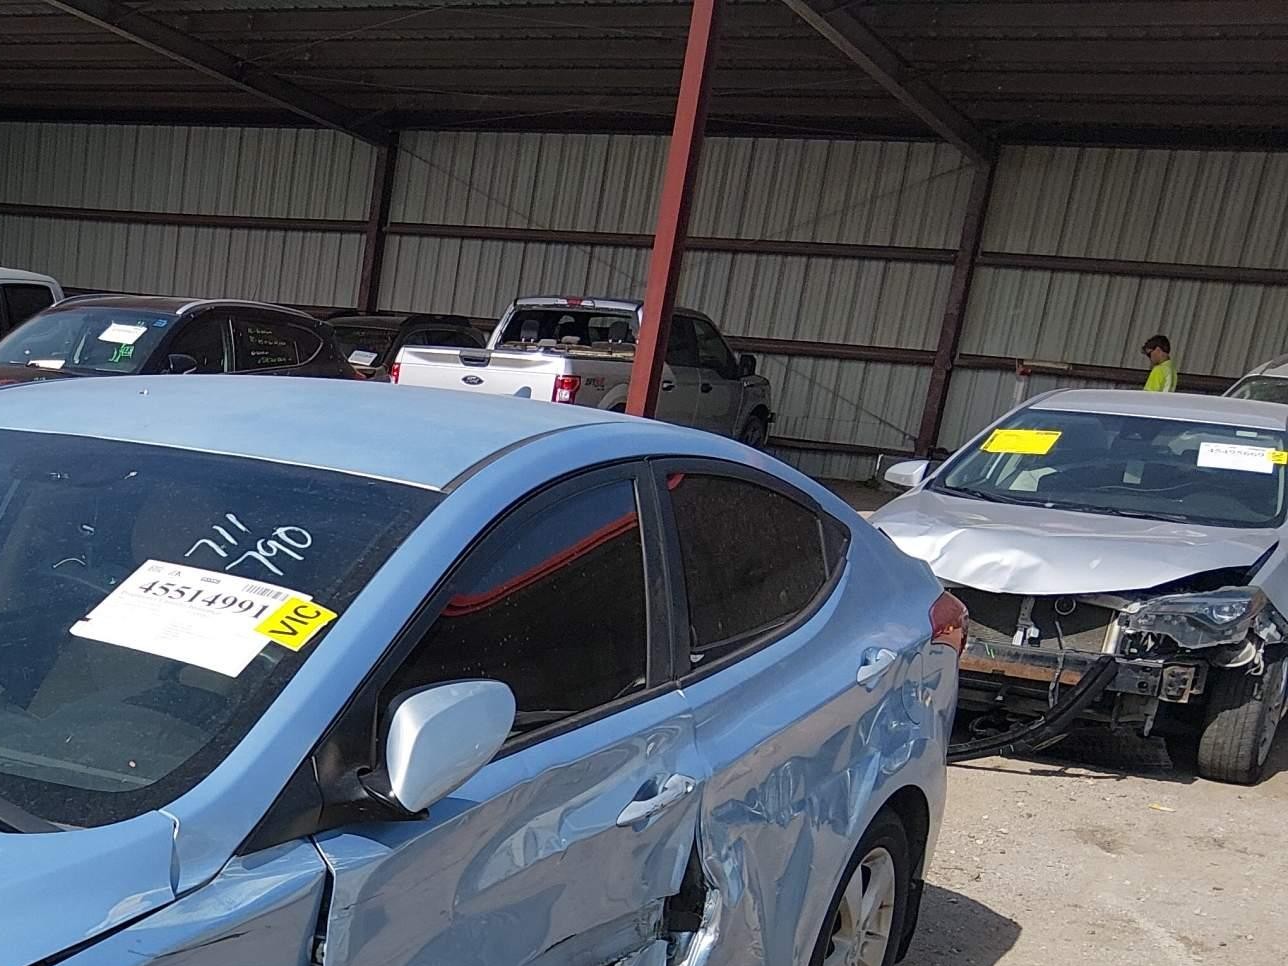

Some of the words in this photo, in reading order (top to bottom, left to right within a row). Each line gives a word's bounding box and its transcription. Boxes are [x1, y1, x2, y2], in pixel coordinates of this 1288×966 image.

[225, 526, 313, 576] 790
[138, 580, 269, 619] 45514991
[269, 604, 322, 637] VIC
